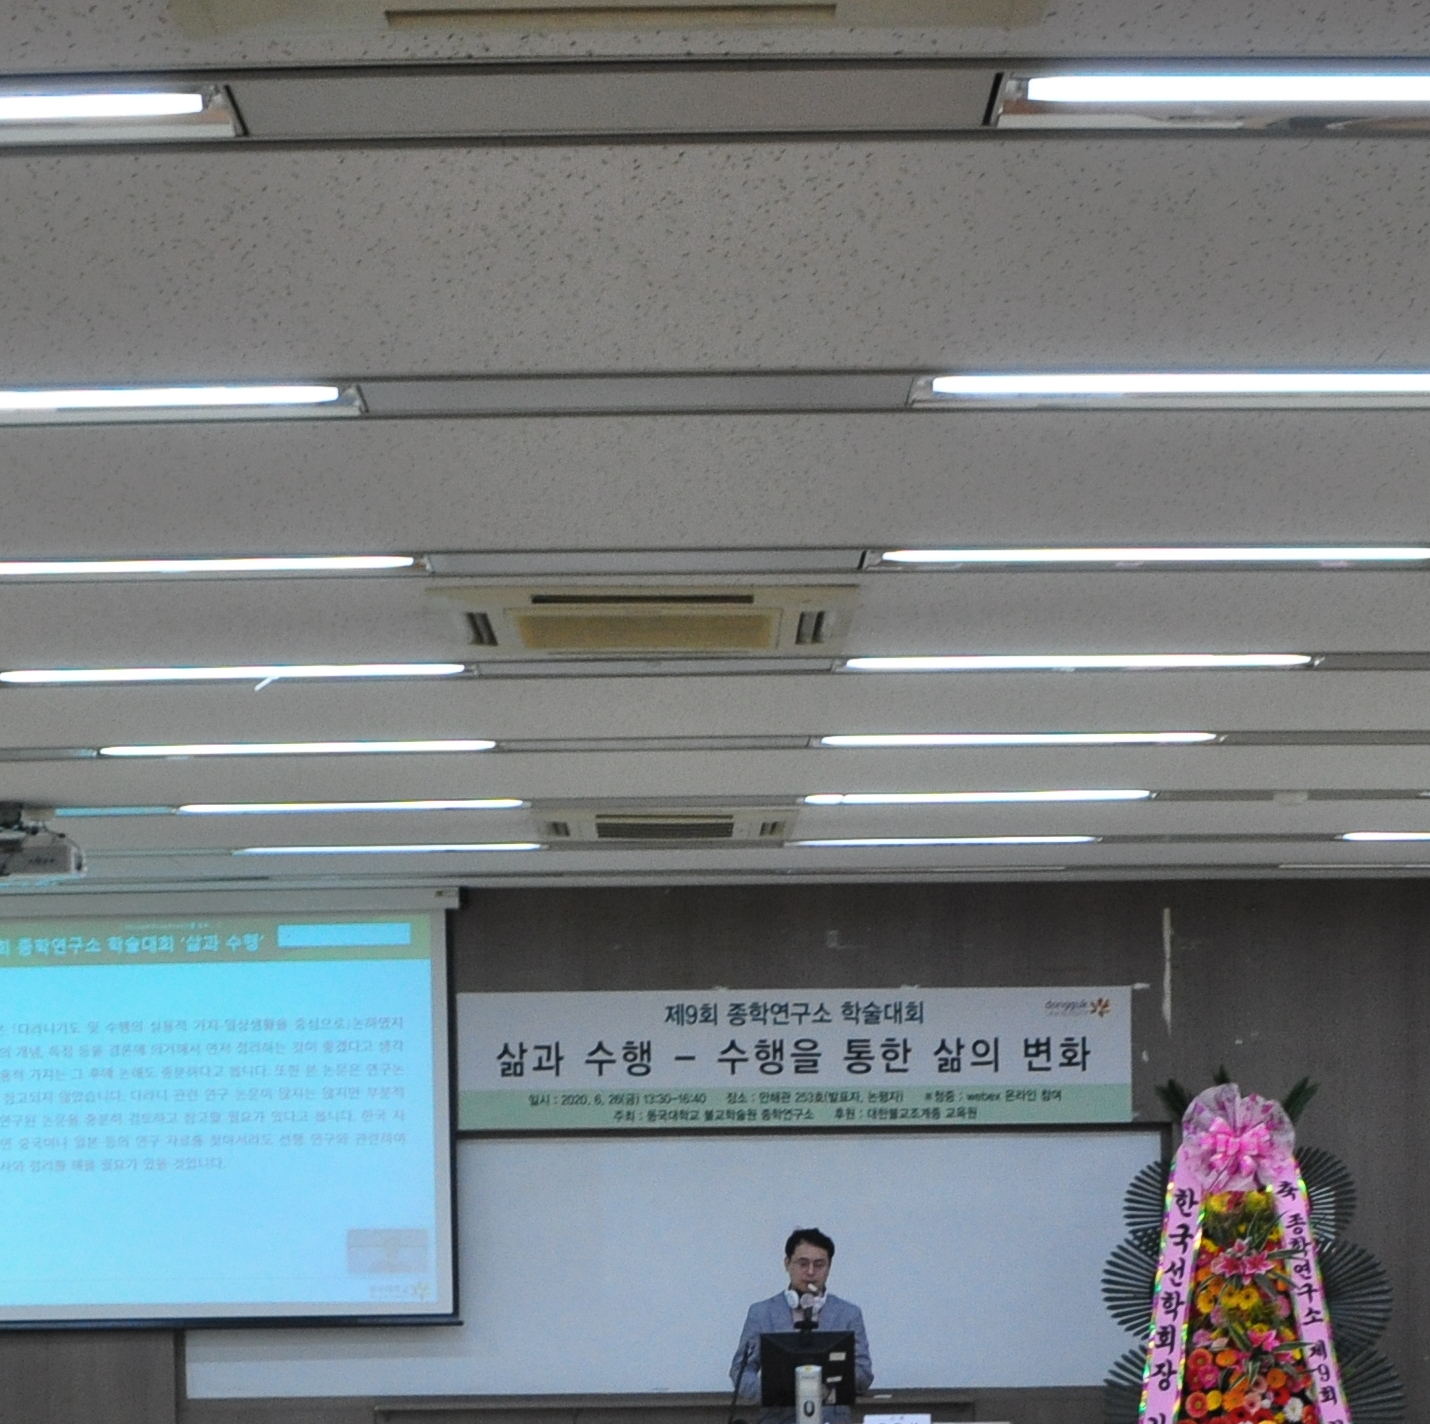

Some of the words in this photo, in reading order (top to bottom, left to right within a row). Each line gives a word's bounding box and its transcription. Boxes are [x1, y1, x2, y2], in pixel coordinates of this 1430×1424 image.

[107, 935, 175, 955] 학술대회
[664, 1003, 718, 1026] 제9회
[726, 1002, 833, 1027] 종학연구소
[840, 1001, 924, 1026] 학술대회
[496, 1041, 565, 1077] 삶과
[584, 1040, 652, 1077] 수행
[716, 1038, 823, 1077] 수행을
[842, 1037, 913, 1076] 통한
[932, 1036, 1000, 1074] 삶의
[1023, 1036, 1092, 1073] 변화
[561, 1094, 591, 1106] 2020.
[646, 1109, 701, 1123] 동국대학교
[1276, 1179, 1298, 1201] 축
[1284, 1212, 1325, 1328] 종학연구소
[1150, 1187, 1198, 1393] 한국선학회장
[1308, 1339, 1339, 1407] 제9회
